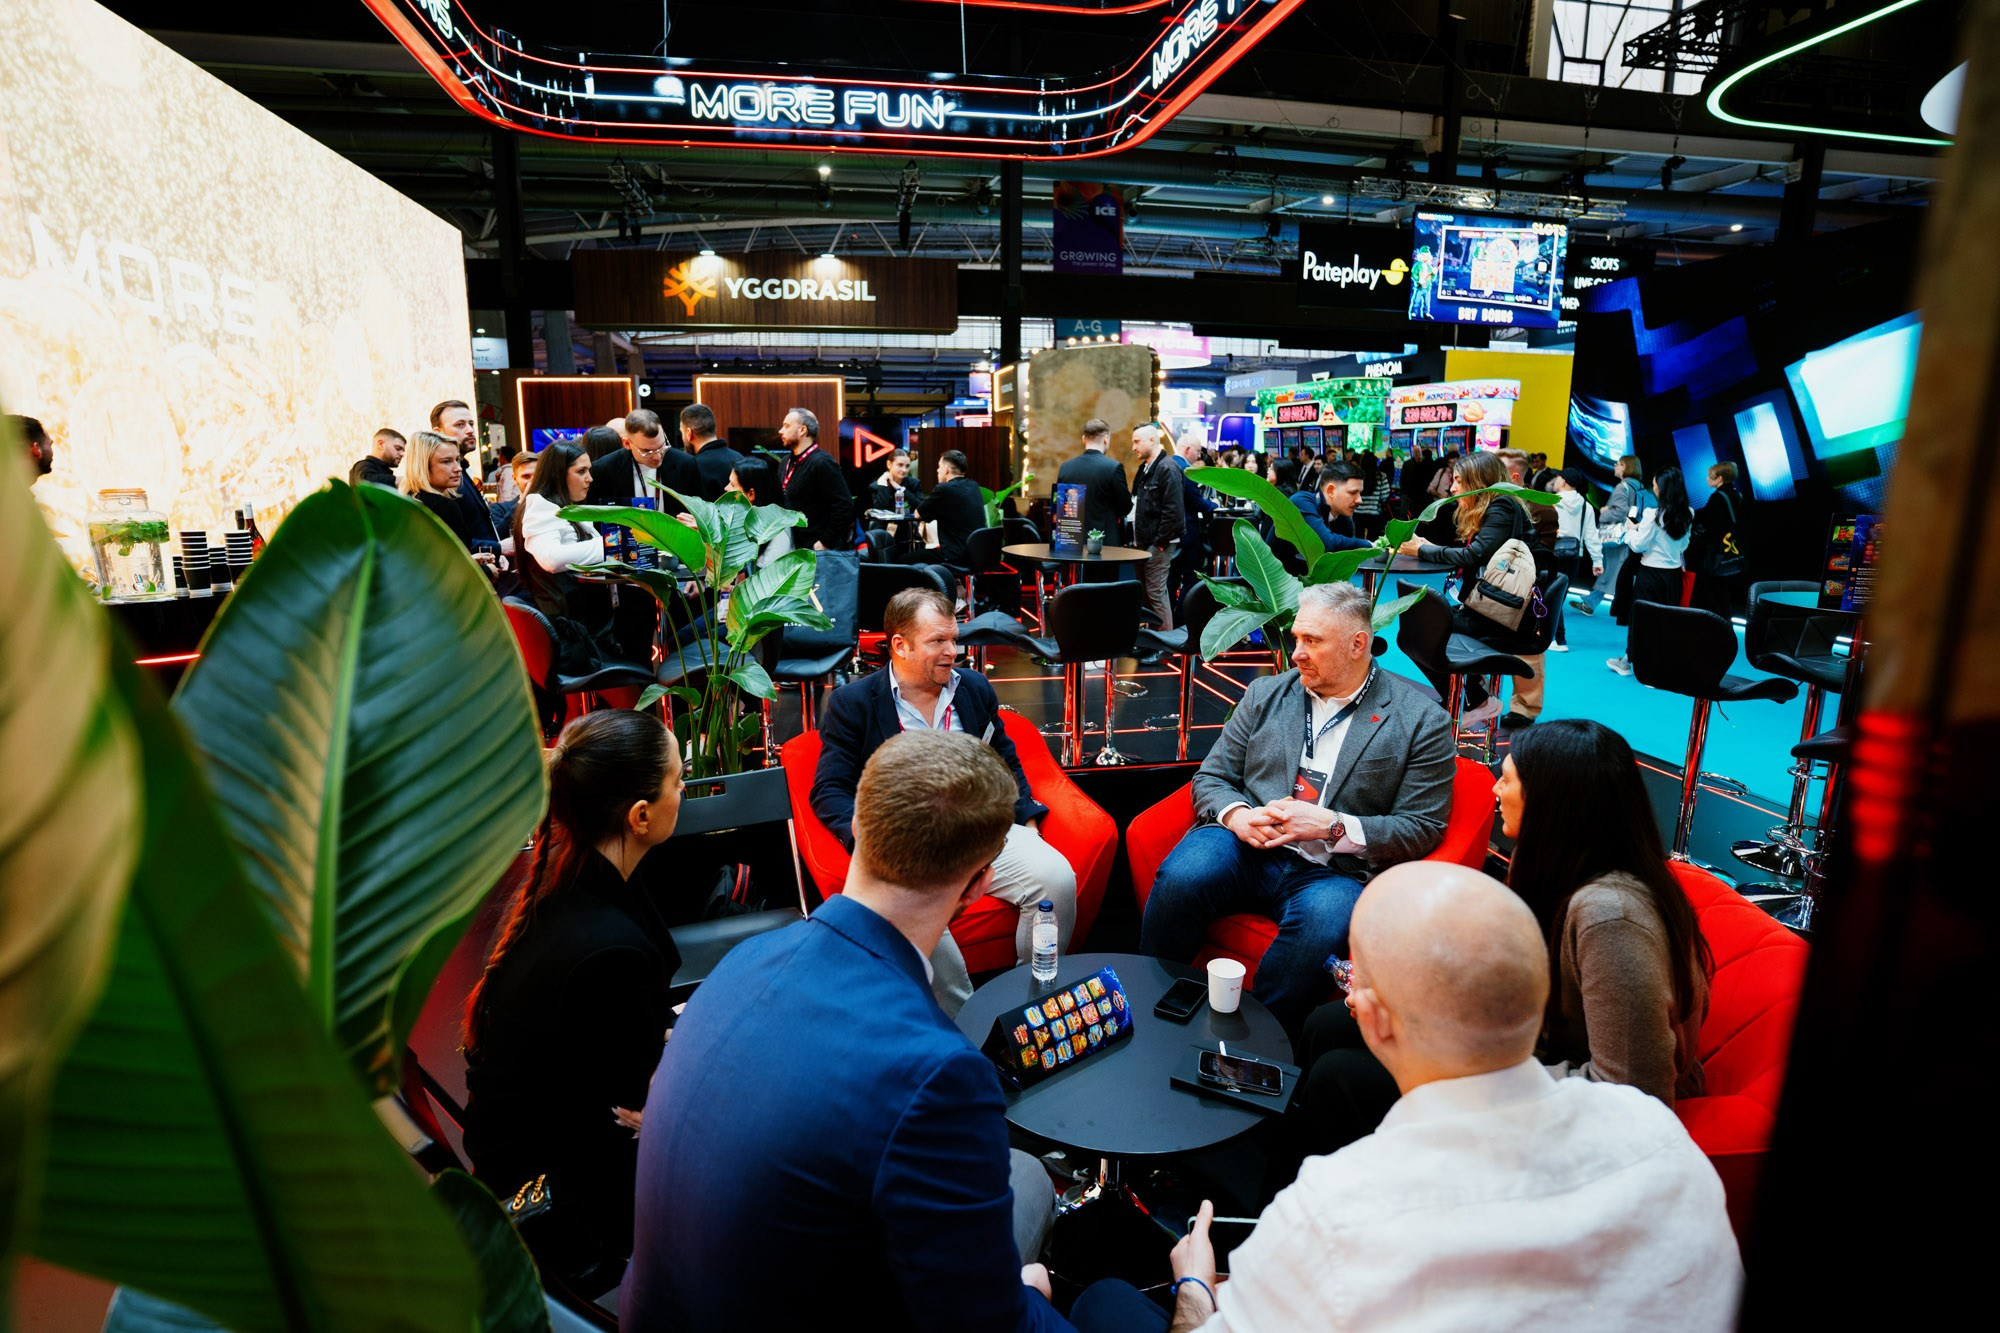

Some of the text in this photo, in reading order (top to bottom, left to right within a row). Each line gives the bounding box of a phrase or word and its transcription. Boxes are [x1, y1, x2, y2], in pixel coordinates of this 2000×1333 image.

[1152, 0, 1219, 90] MORE
[690, 83, 945, 130] MORE FUN
[1095, 205, 1116, 216] ICE
[1531, 222, 1568, 237] SLOTS
[1060, 250, 1117, 263] GROWING
[1590, 257, 1620, 271] SLOTS
[28, 213, 258, 338] MORE
[1303, 251, 1381, 290] Pateplay
[723, 277, 877, 302] YGGDRASIL
[1481, 308, 1513, 323] BONUS
[1074, 320, 1102, 332] A-G
[1365, 361, 1402, 378] PHENOM
